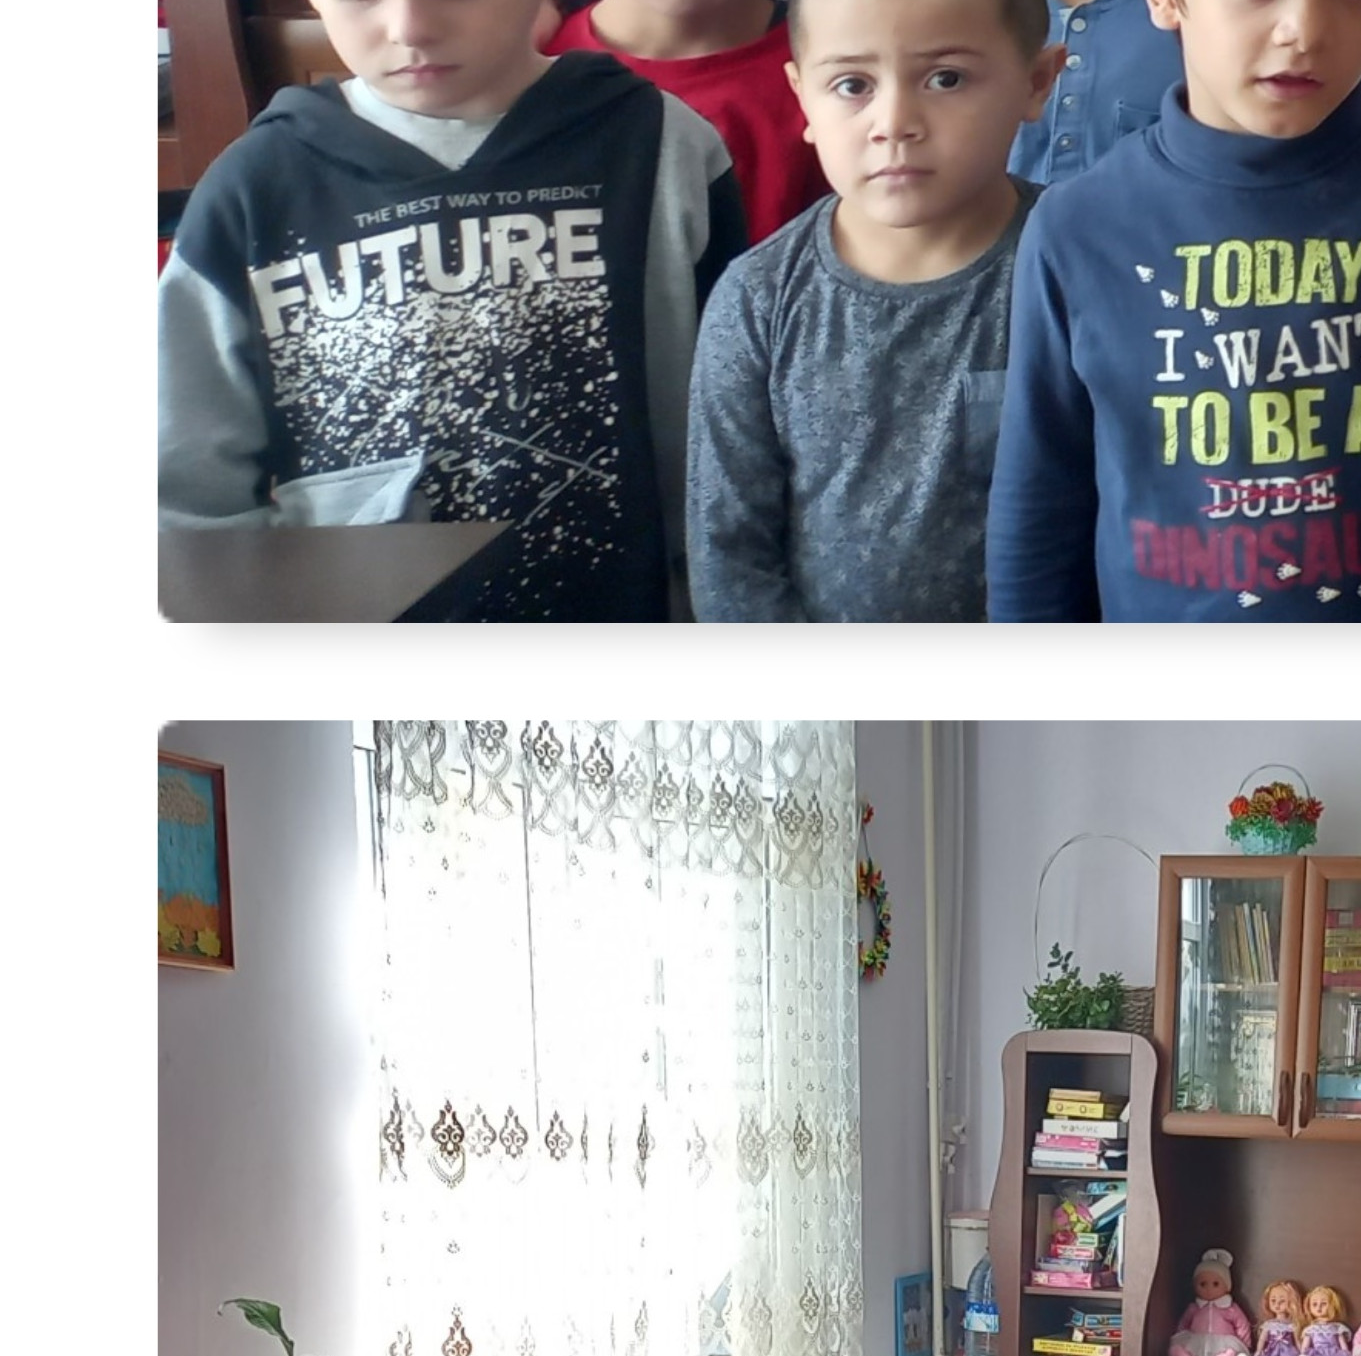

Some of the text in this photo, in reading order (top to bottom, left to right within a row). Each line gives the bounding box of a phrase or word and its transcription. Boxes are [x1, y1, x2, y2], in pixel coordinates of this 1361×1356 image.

[353, 184, 603, 229] THE BEST WAY TO PREDICT
[249, 208, 606, 340] FUTURE
[1154, 329, 1185, 382] I
[1152, 391, 1230, 465] TO
[1249, 389, 1328, 465] BE
[1206, 472, 1337, 519] DUDE
